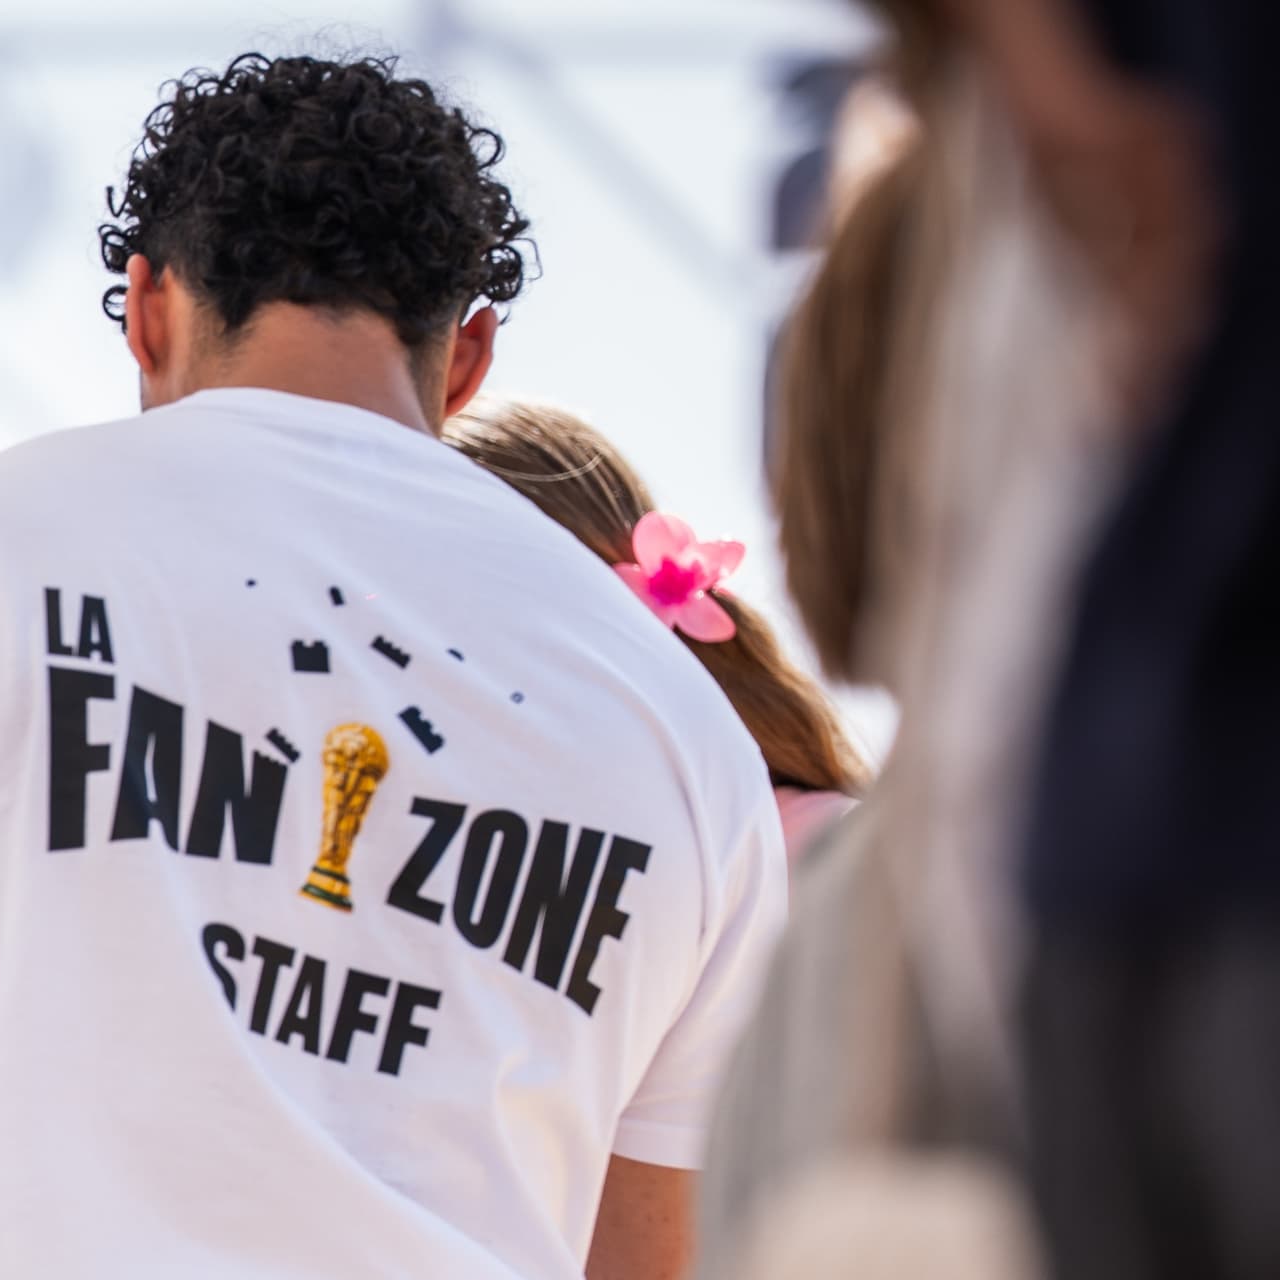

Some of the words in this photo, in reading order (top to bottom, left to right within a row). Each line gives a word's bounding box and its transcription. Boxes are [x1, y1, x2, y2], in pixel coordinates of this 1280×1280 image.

[44, 586, 114, 664] LA
[46, 666, 290, 866] FAN
[386, 796, 653, 1017] ZONE
[201, 922, 443, 1077] STAFF
